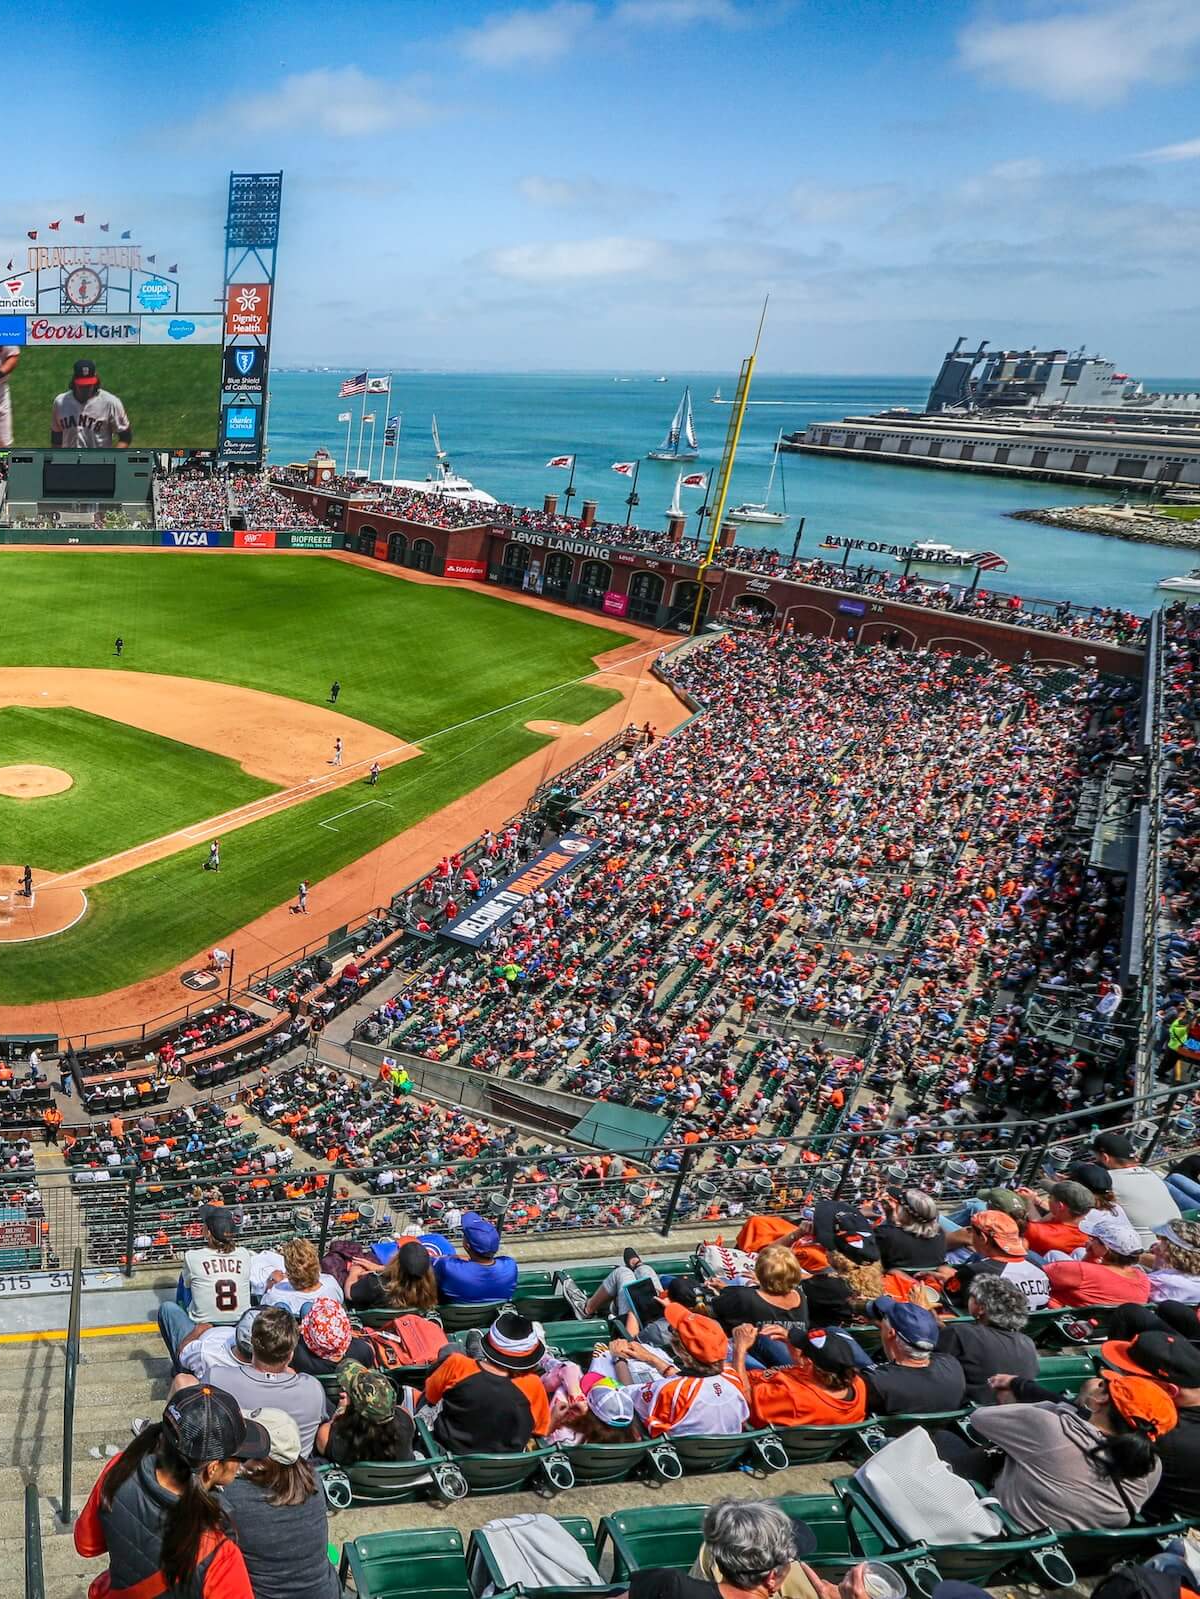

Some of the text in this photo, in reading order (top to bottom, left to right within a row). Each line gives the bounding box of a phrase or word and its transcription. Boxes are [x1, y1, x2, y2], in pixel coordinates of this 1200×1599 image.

[142, 284, 168, 294] coupa
[232, 314, 262, 324] Dignity
[31, 319, 130, 340] Coors LIGHT
[171, 531, 208, 546] VISA
[291, 536, 332, 544] BIOFREEZE
[547, 538, 610, 560] LANDING
[825, 535, 964, 566] BANK OF AMERICA
[451, 900, 512, 938] WELCOME
[507, 866, 555, 895] ORACLE
[536, 852, 573, 872] PARK
[202, 1258, 242, 1275] PENCE
[215, 1279, 238, 1311] 8
